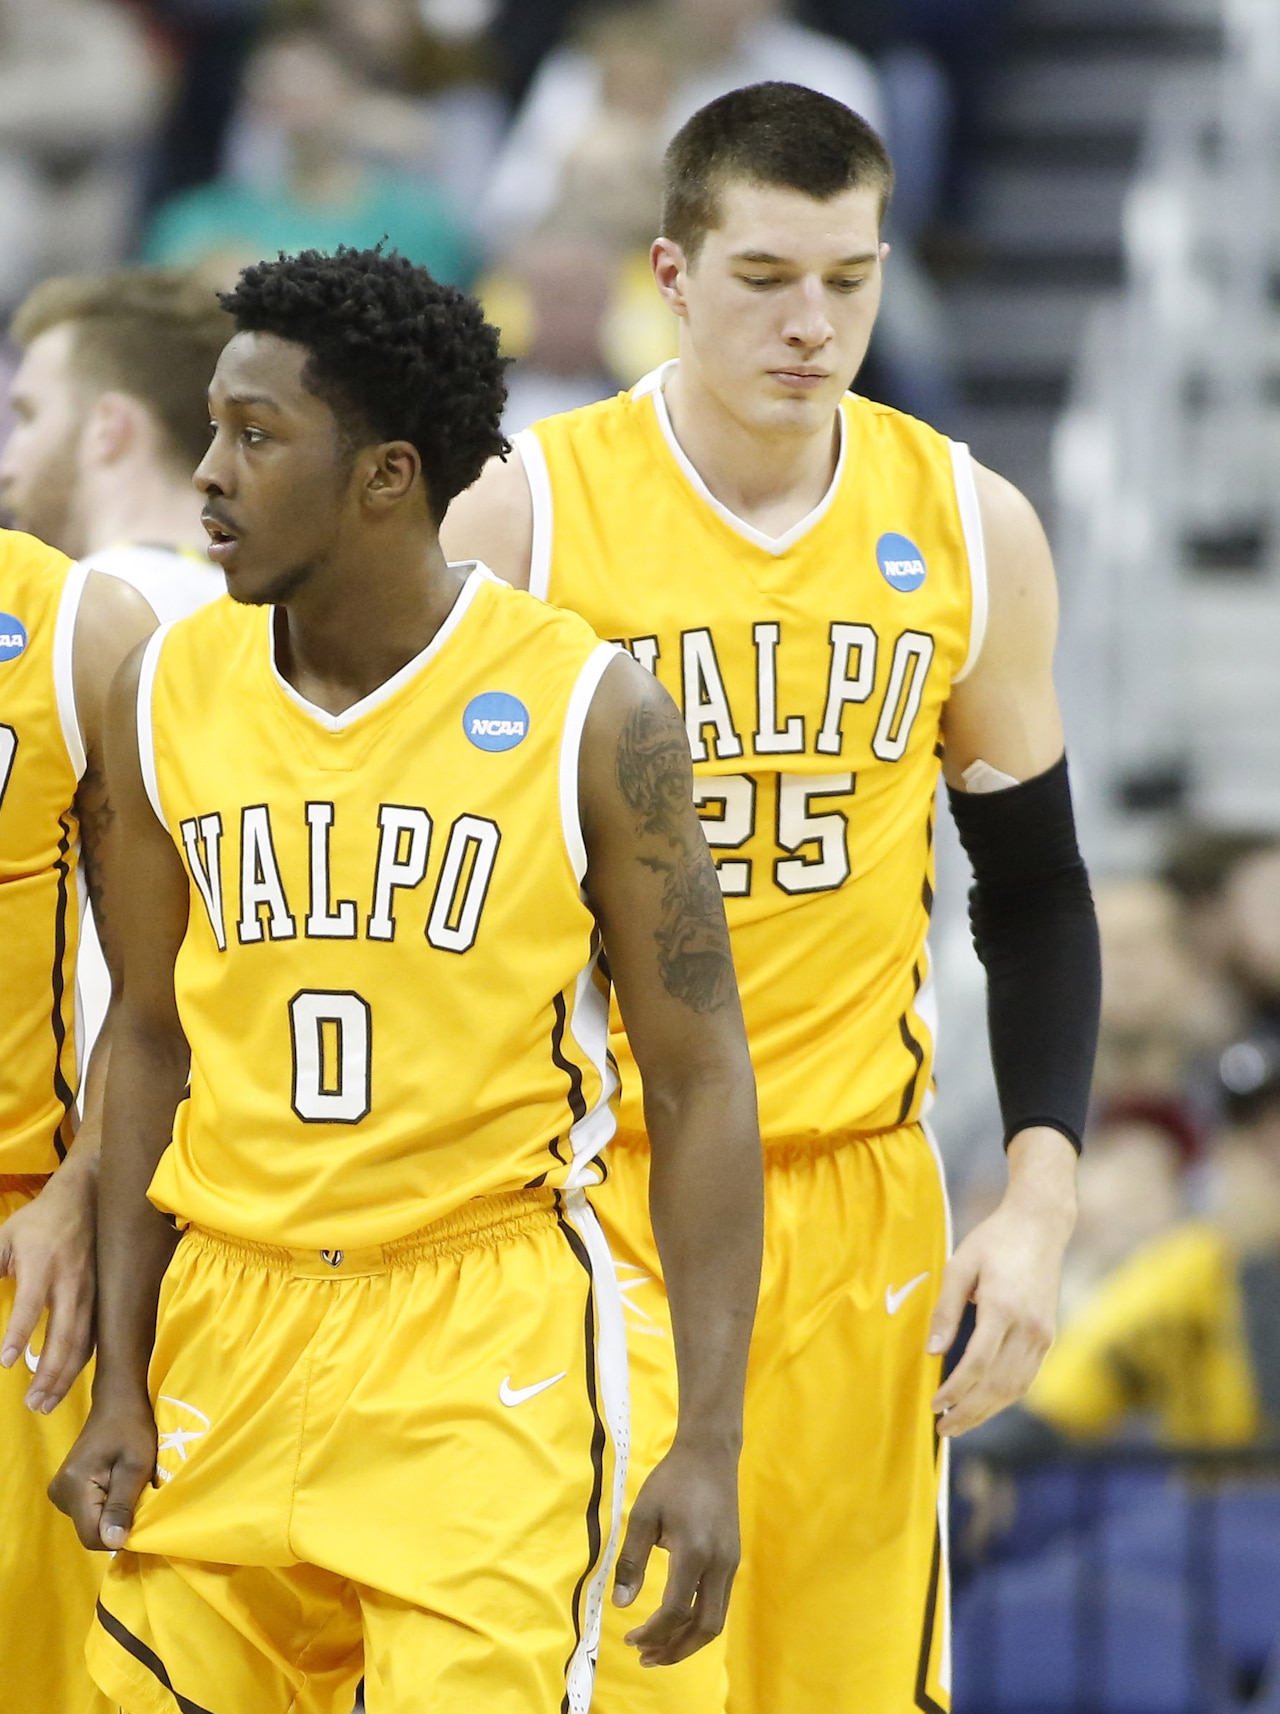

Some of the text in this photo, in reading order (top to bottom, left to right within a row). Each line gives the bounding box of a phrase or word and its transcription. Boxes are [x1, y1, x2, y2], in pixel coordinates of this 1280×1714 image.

[883, 560, 926, 576] NCAA
[470, 718, 524, 736] NCAA
[179, 800, 502, 955] VALPO
[287, 988, 371, 1124] 0
